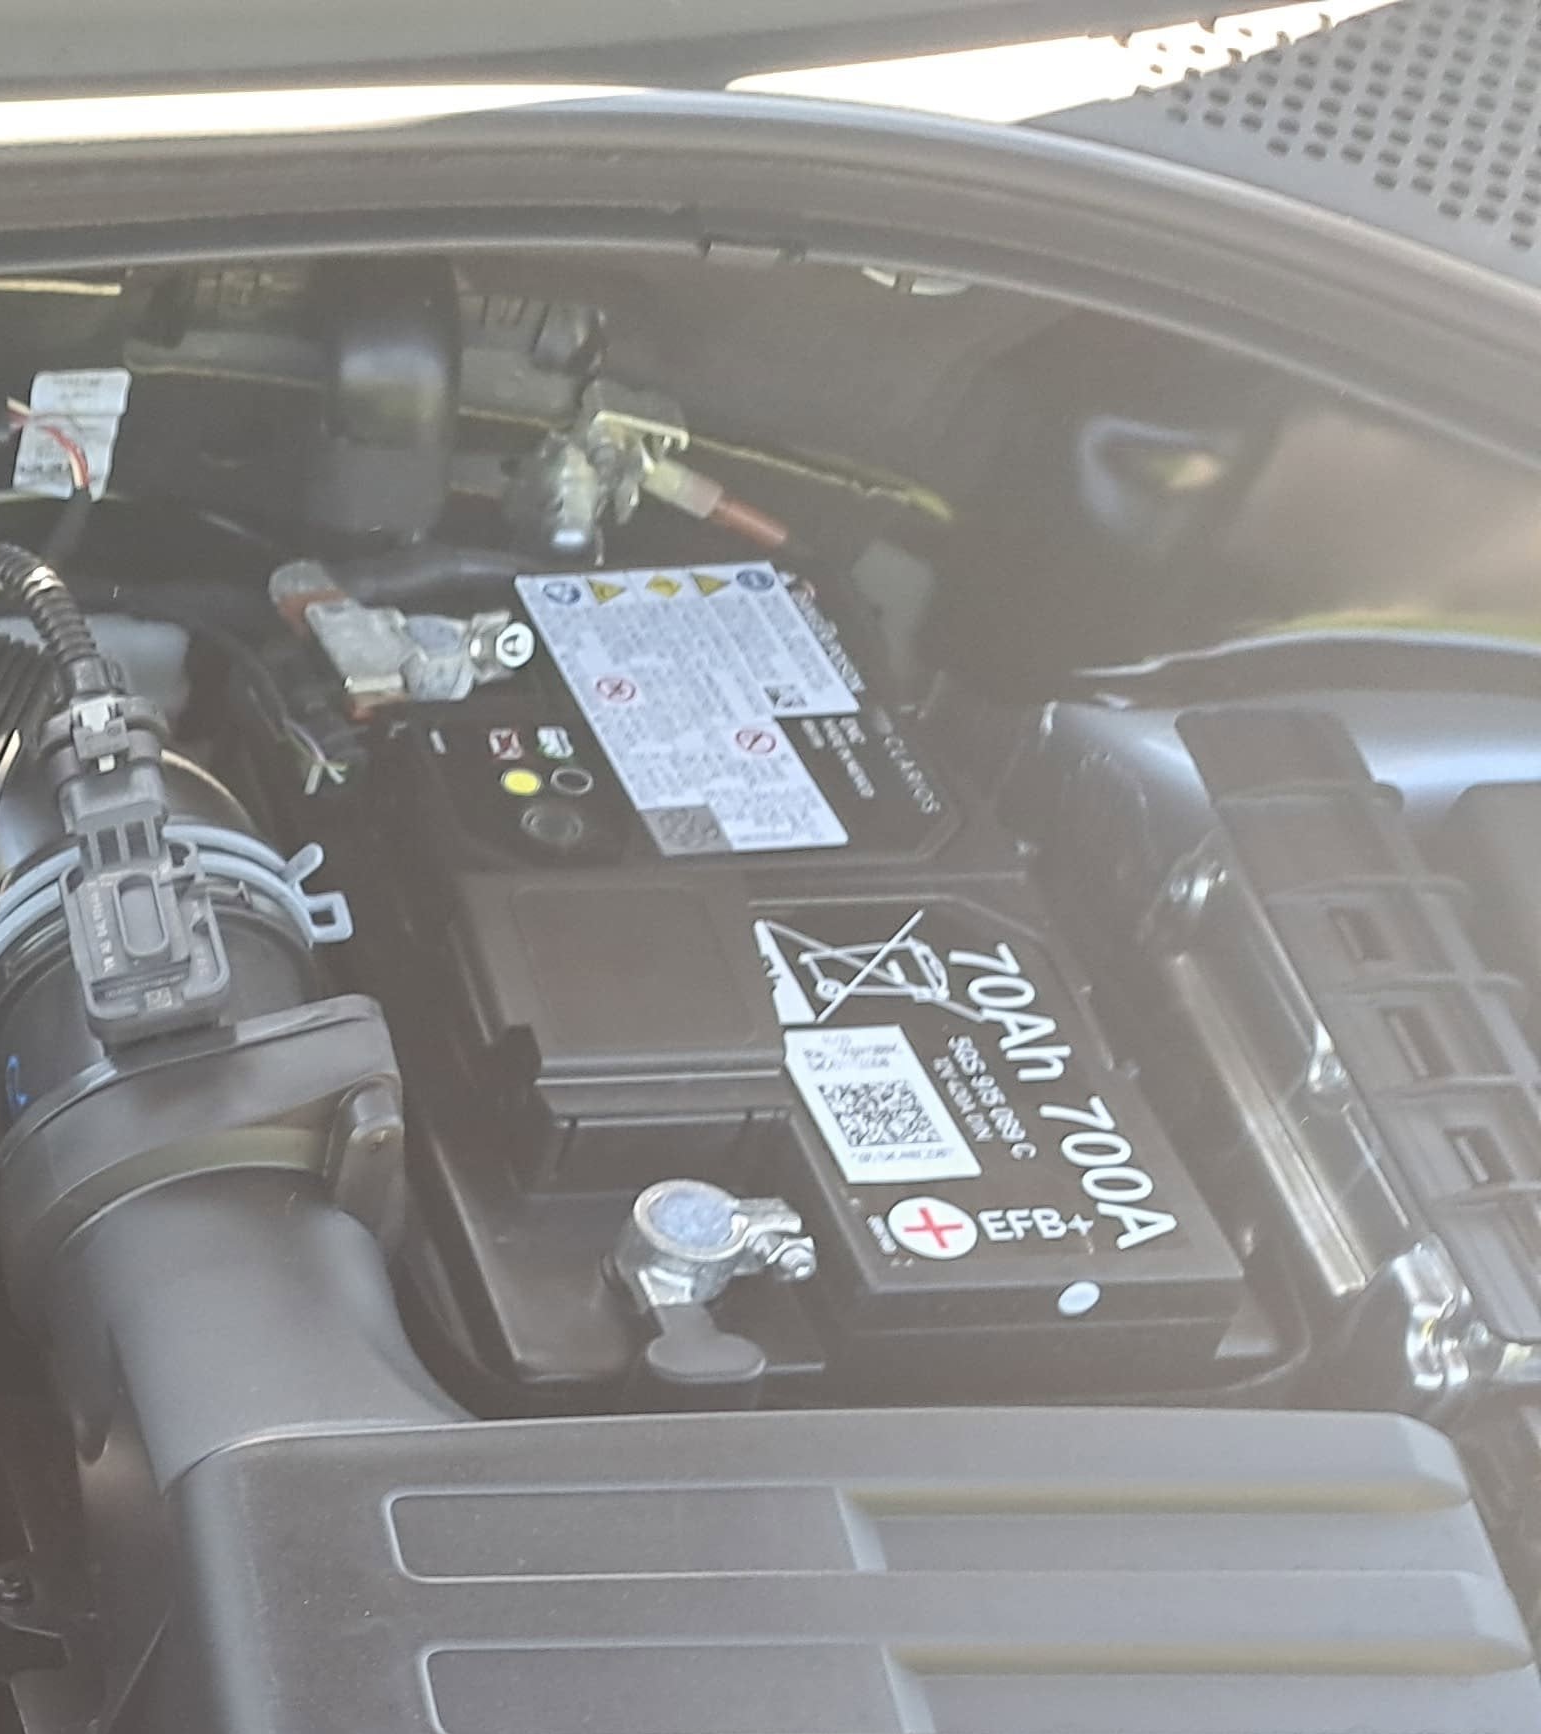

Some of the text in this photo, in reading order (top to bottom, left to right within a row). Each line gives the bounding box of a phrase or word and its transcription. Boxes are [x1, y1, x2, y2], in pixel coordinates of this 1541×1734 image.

[948, 942, 1178, 1250] 70Ah 700A
[977, 1206, 1094, 1241] EFB+
